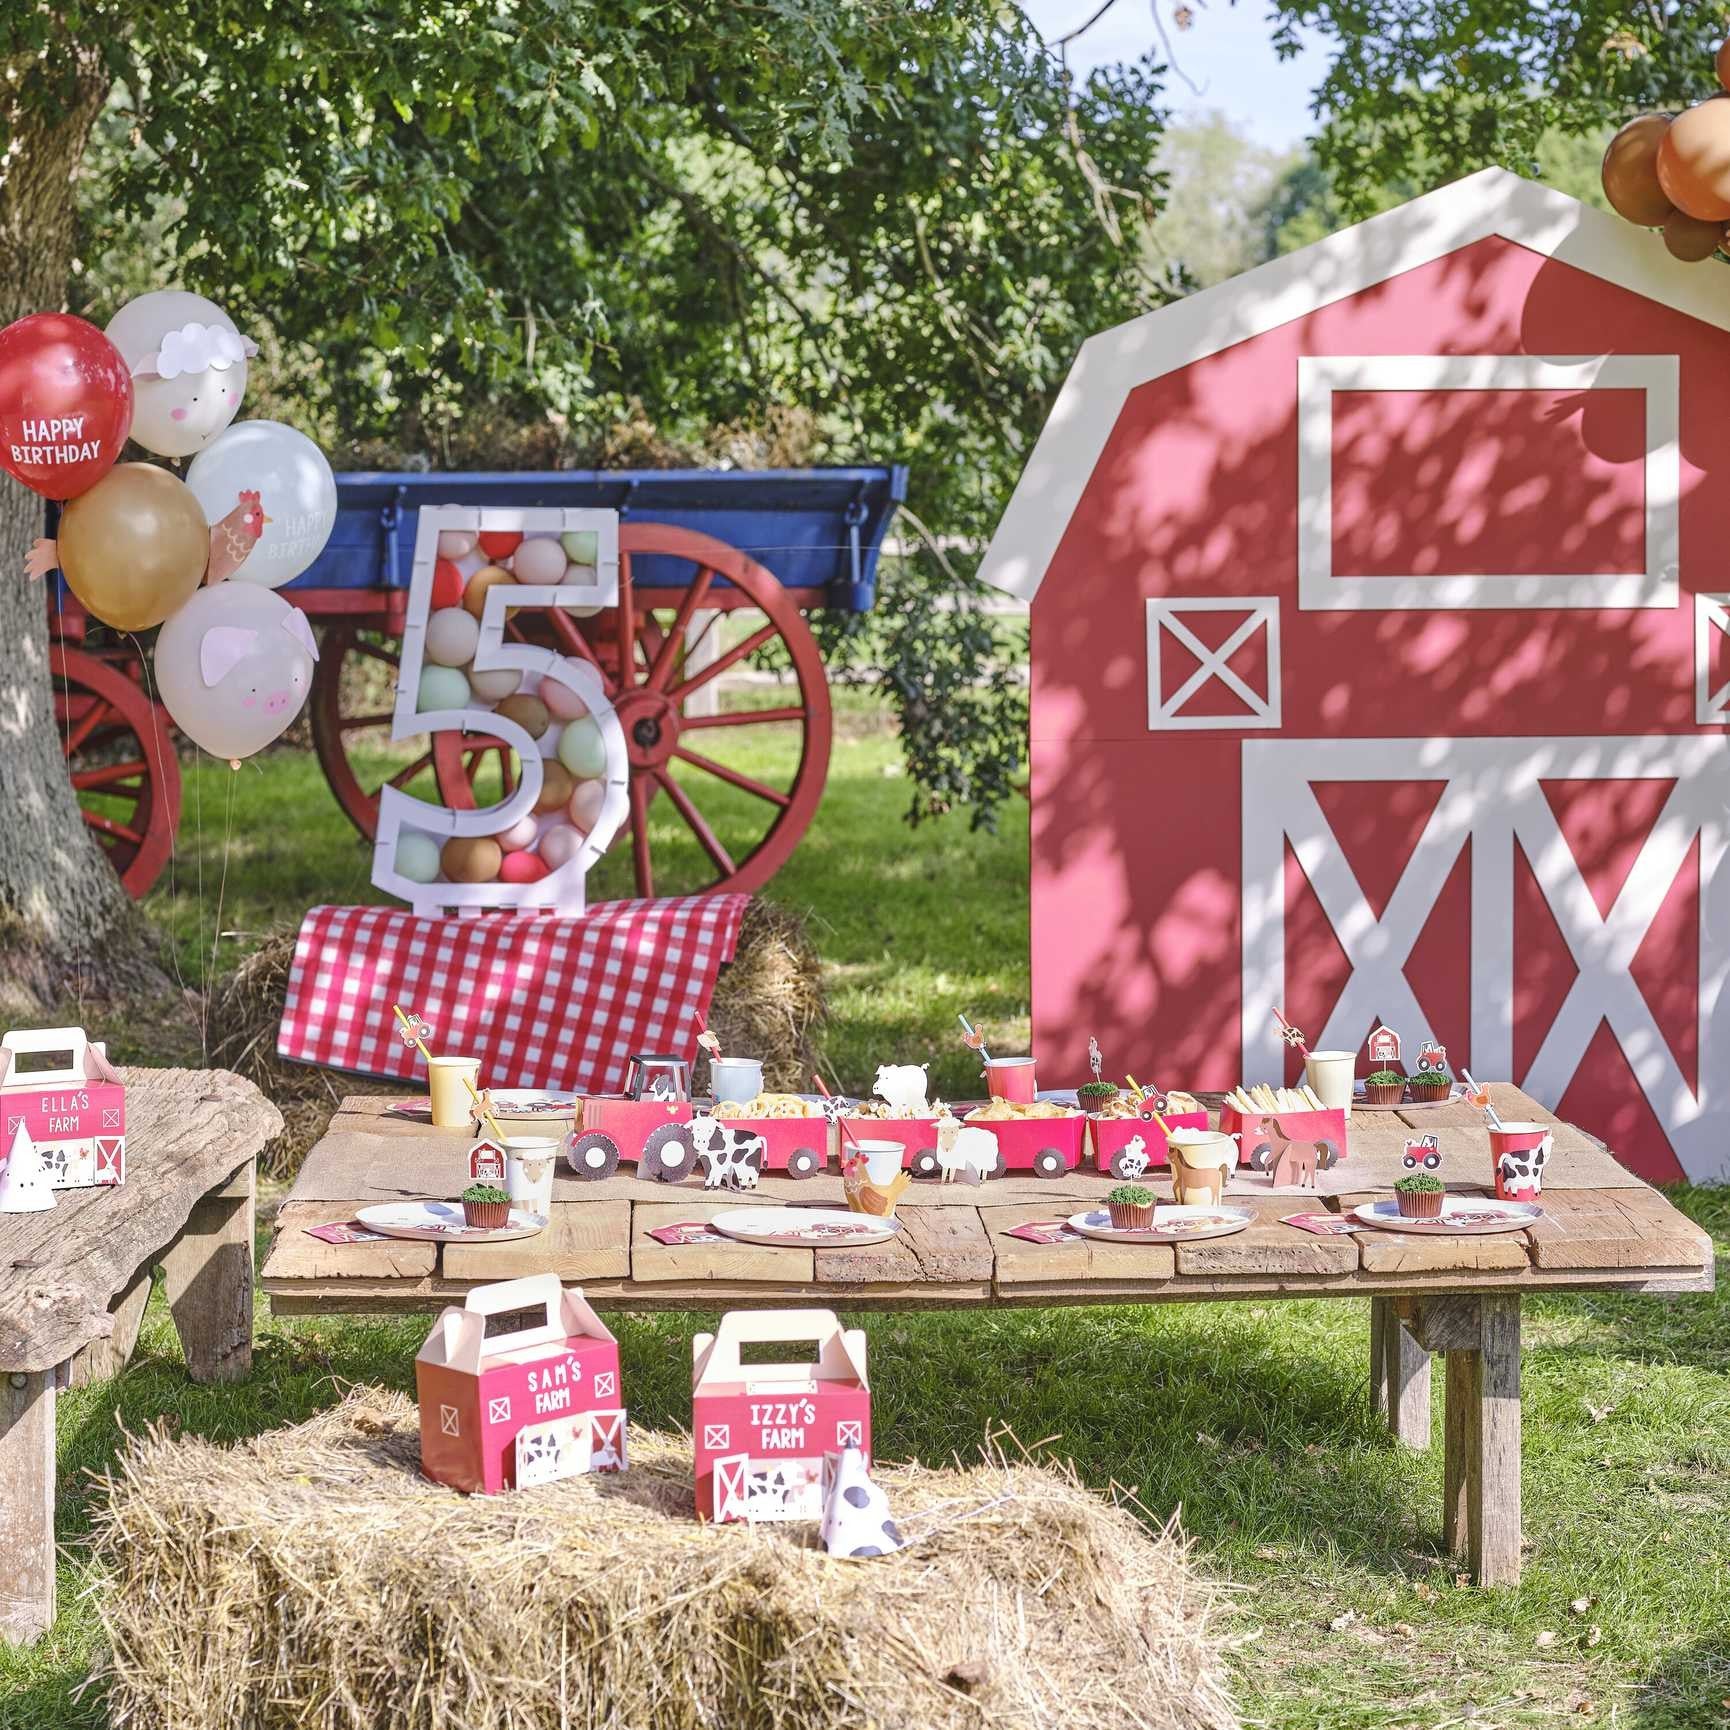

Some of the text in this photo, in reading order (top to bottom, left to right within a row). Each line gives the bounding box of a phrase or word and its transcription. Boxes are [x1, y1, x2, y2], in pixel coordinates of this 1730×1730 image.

[22, 416, 84, 442] HAPPY
[10, 439, 101, 465] BIRTHDAY
[41, 1090, 89, 1113] ELLA'S
[49, 1115, 79, 1133] FARM
[527, 1355, 582, 1392] SAM'S
[535, 1387, 571, 1415] FARM
[750, 1398, 816, 1426] IZZY'S
[761, 1427, 805, 1450] FARM
